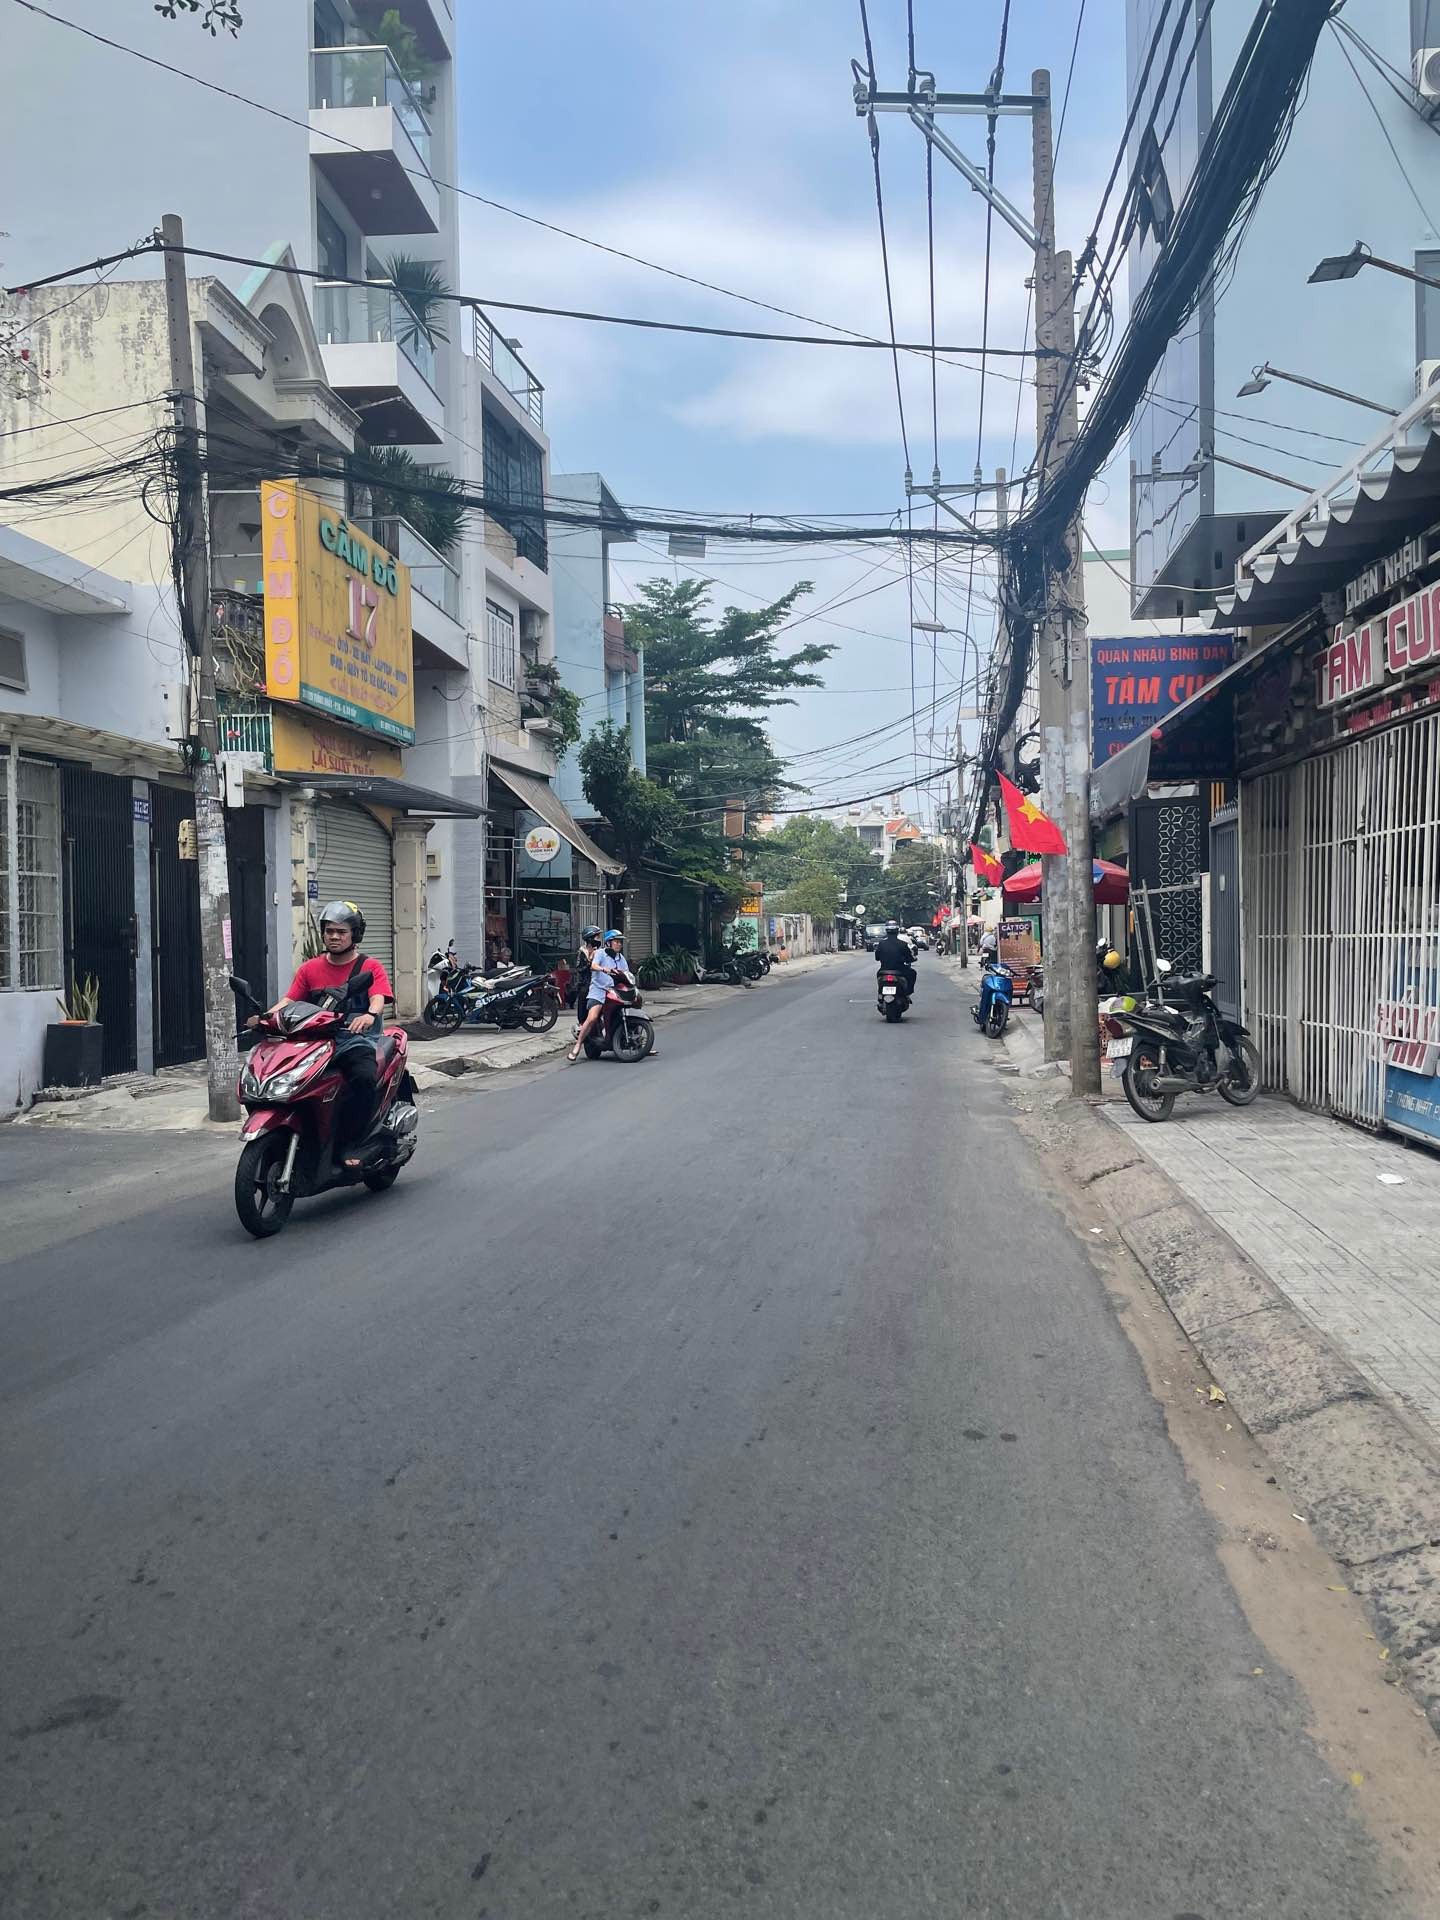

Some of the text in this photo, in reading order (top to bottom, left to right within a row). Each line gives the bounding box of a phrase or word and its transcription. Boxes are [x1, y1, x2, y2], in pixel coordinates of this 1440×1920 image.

[1133, 645, 1166, 665] NHẬU
[1312, 621, 1375, 709] TÁM
[1105, 672, 1162, 705] TÁM
[474, 988, 517, 1009] SUZUKI
